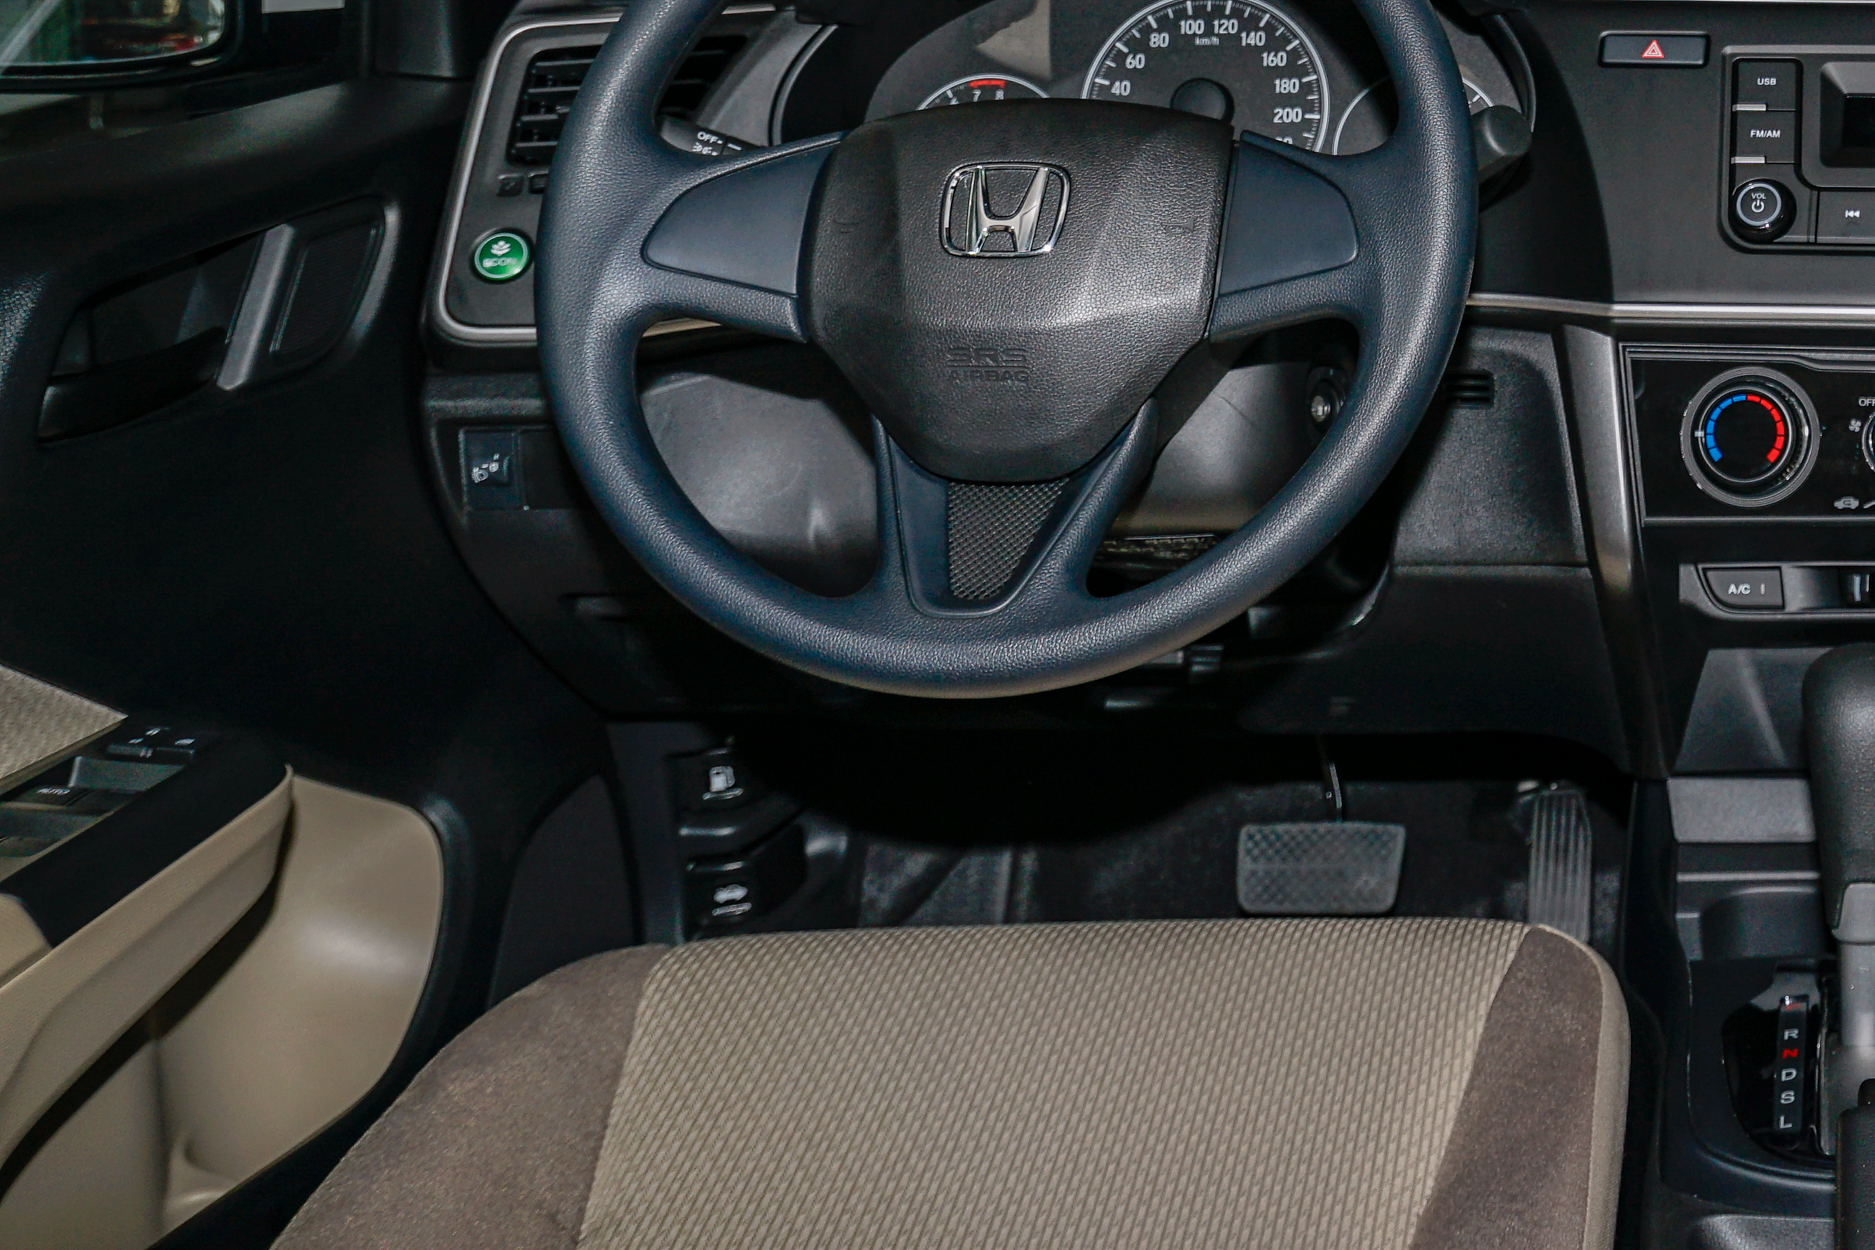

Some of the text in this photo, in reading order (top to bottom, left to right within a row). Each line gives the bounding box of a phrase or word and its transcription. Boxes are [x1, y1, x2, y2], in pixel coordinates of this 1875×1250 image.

[1180, 19, 1205, 35] 100
[1213, 18, 1239, 35] 120
[1149, 32, 1170, 48] 80
[1195, 36, 1220, 46] km/h
[1241, 31, 1266, 47] 140
[1125, 53, 1146, 69] 60
[1262, 51, 1288, 67] 160
[1110, 80, 1131, 96] 40
[1274, 78, 1300, 94] 180
[1756, 78, 1777, 86] USB
[972, 89, 981, 102] 7
[1272, 107, 1302, 124] 200
[697, 131, 718, 144] OFF
[1750, 130, 1781, 138] FM/AM
[947, 347, 1029, 367] SRS
[947, 369, 1030, 382] AIRBAG
[1728, 583, 1751, 595] A/C
[1784, 1028, 1799, 1040] R
[1782, 1048, 1798, 1059] N
[1781, 1068, 1797, 1080] D
[1780, 1091, 1795, 1104] S
[1778, 1115, 1792, 1129] L
